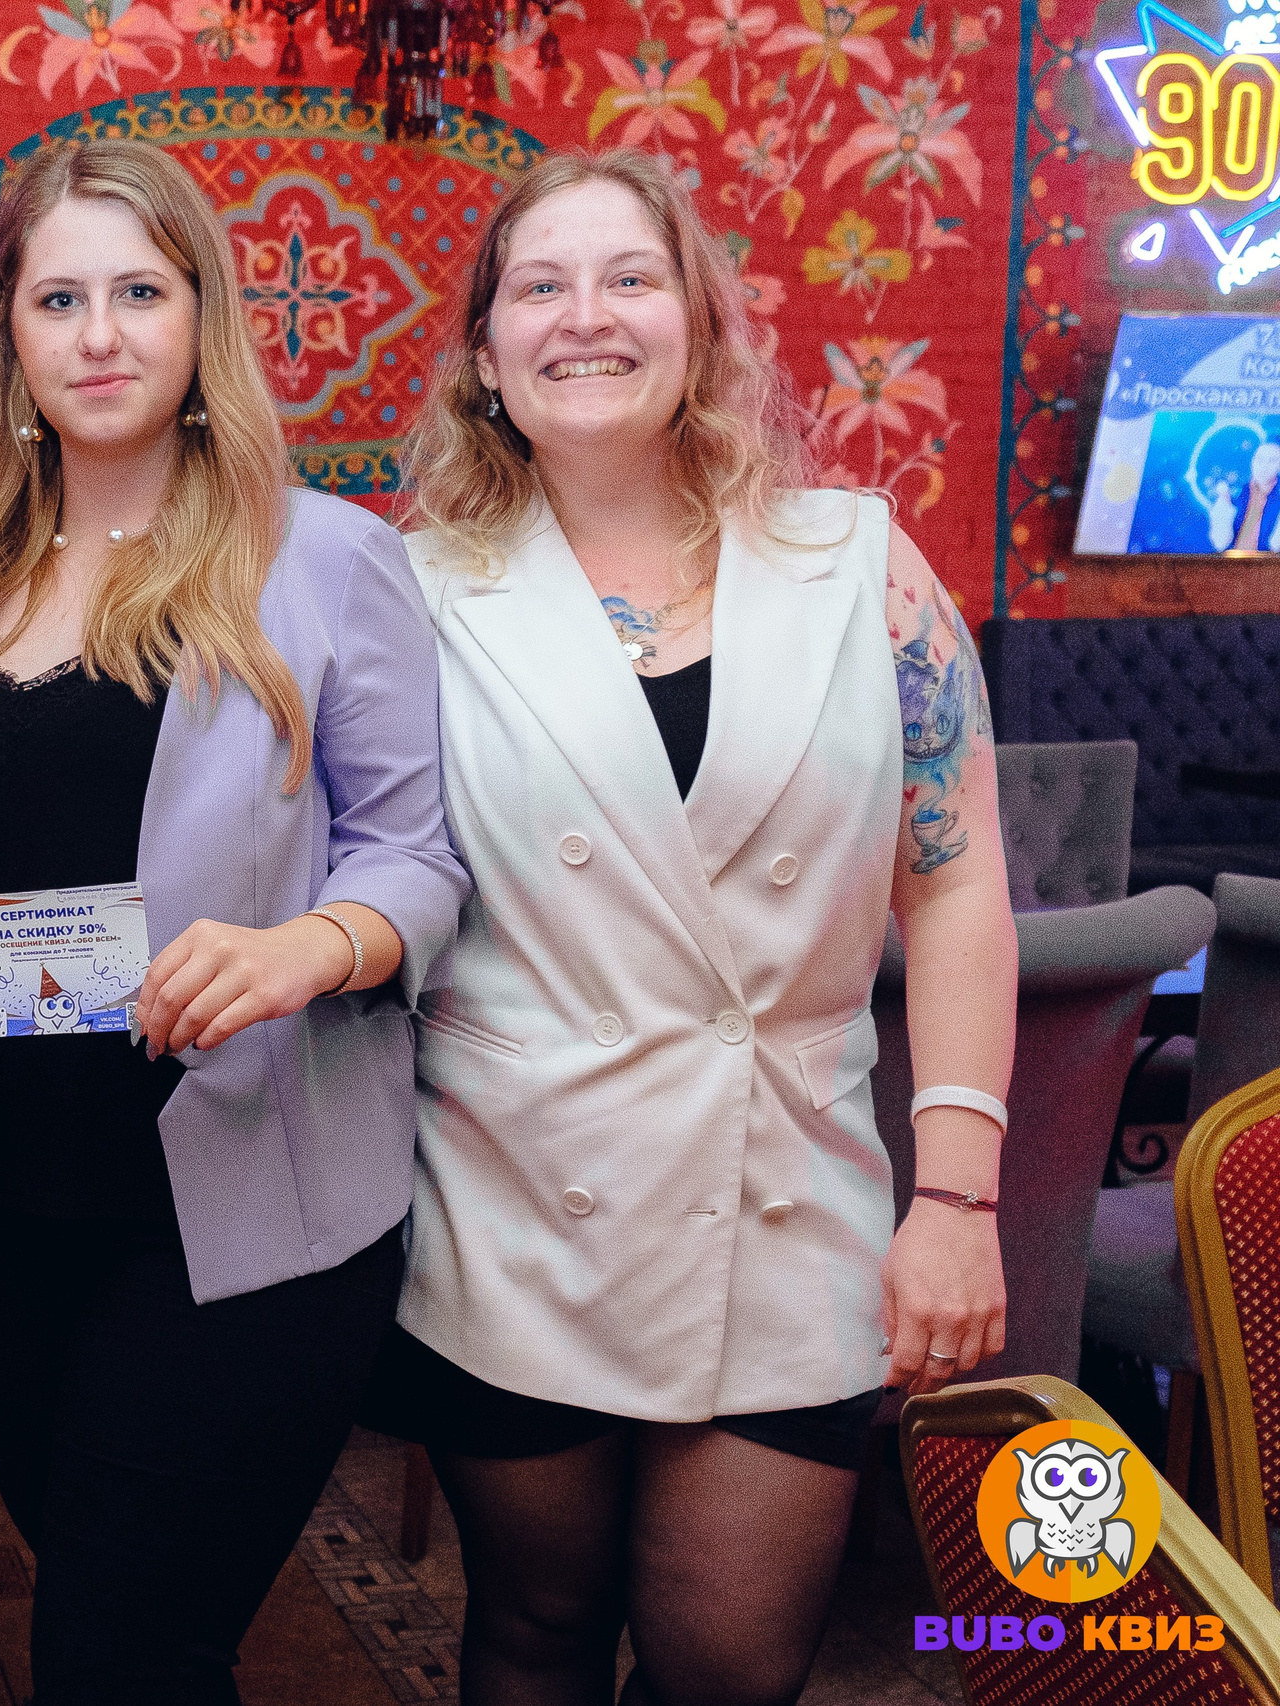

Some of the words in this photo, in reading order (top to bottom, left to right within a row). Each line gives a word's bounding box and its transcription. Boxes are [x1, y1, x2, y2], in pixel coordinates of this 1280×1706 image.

[0, 905, 95, 922] СЕРТИФИКАТ
[17, 925, 75, 940] СКИДКУ
[78, 923, 107, 935] 50%
[44, 938, 71, 946] КВИЗА
[72, 936, 94, 944] «ОБО
[95, 935, 122, 943] ВСЕМ»
[22, 949, 53, 957] команды
